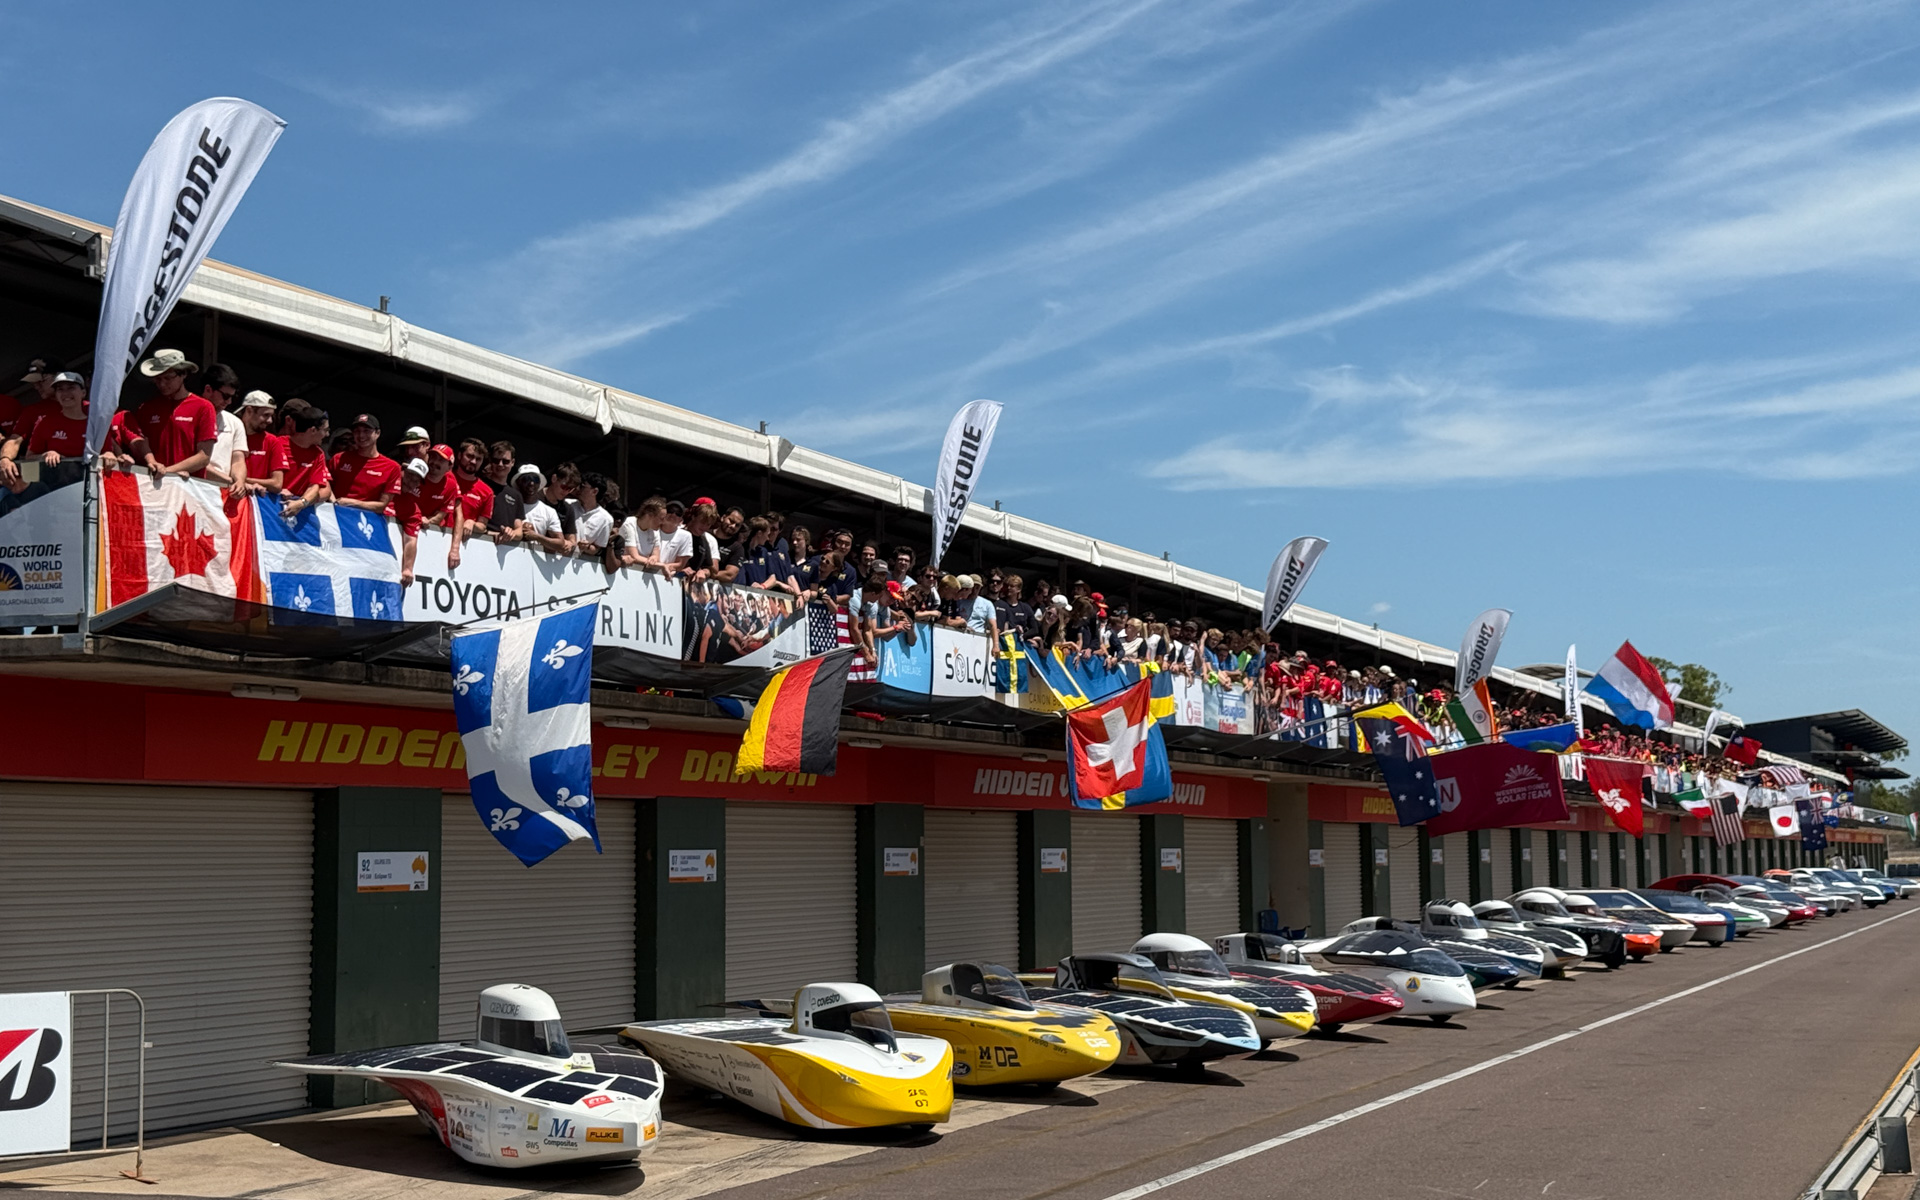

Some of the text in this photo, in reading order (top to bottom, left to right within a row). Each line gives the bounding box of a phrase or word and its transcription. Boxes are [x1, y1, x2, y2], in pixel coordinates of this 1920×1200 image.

[124, 126, 231, 374] DGESTONE
[0, 543, 63, 559] DGESTONE
[23, 560, 63, 571] WORLD
[24, 571, 63, 582] SOLAR
[24, 582, 63, 590] CHALLENGE
[0, 597, 64, 606] OLARCHALLENGE.ORG
[415, 574, 521, 621] TOYOTA
[1464, 622, 1494, 689] BRIDGES
[945, 653, 997, 687] SOLCAS
[257, 720, 467, 769] HIDDEN
[973, 769, 1055, 797] HIDDEN
[1497, 788, 1552, 805] SOLAR TEAM
[361, 859, 371, 872] 92
[816, 994, 840, 1007] covestro
[978, 1046, 992, 1060] M
[994, 1046, 1022, 1068] 02
[548, 1117, 576, 1139] M1
[589, 1131, 620, 1139] FLUKE
[543, 1138, 578, 1149] Composites
